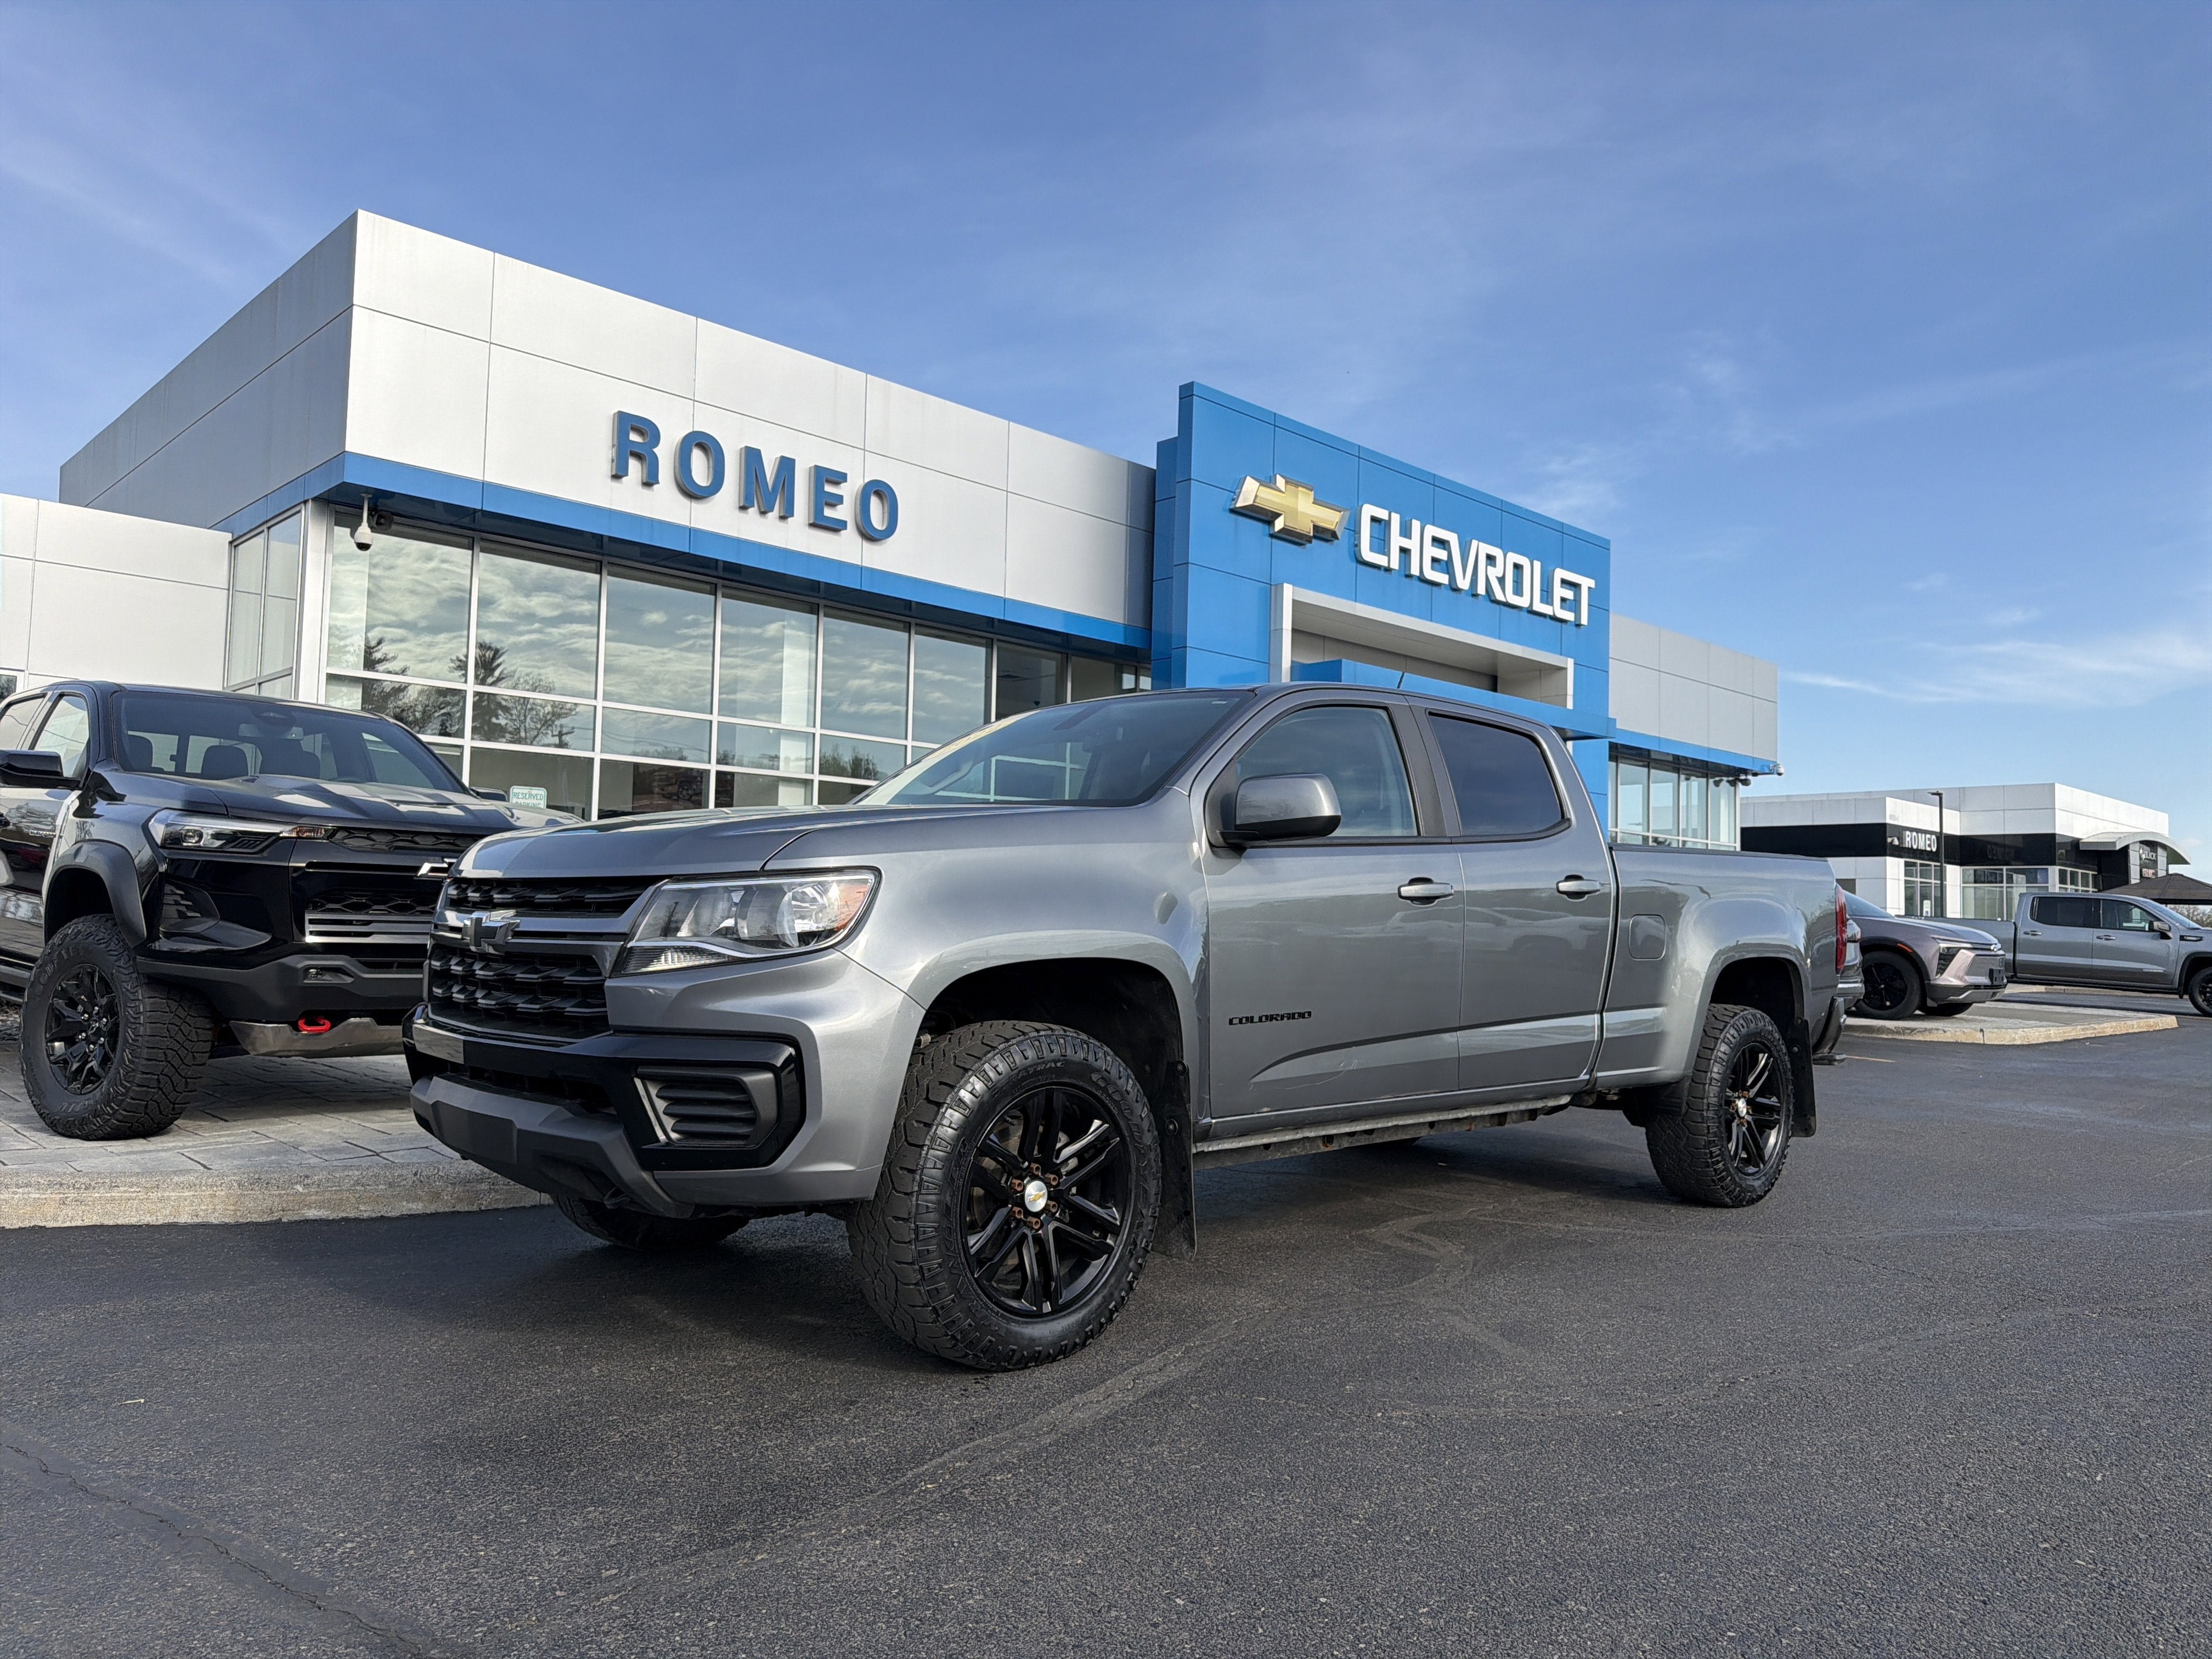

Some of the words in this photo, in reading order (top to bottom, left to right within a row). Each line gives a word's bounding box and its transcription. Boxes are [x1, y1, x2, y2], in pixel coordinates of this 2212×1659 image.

[611, 410, 899, 540] ROMEO
[1357, 503, 1595, 626] CHEVROLET
[1905, 831, 1937, 852] ROMEO
[1228, 1011, 1312, 1026] COLORADO
